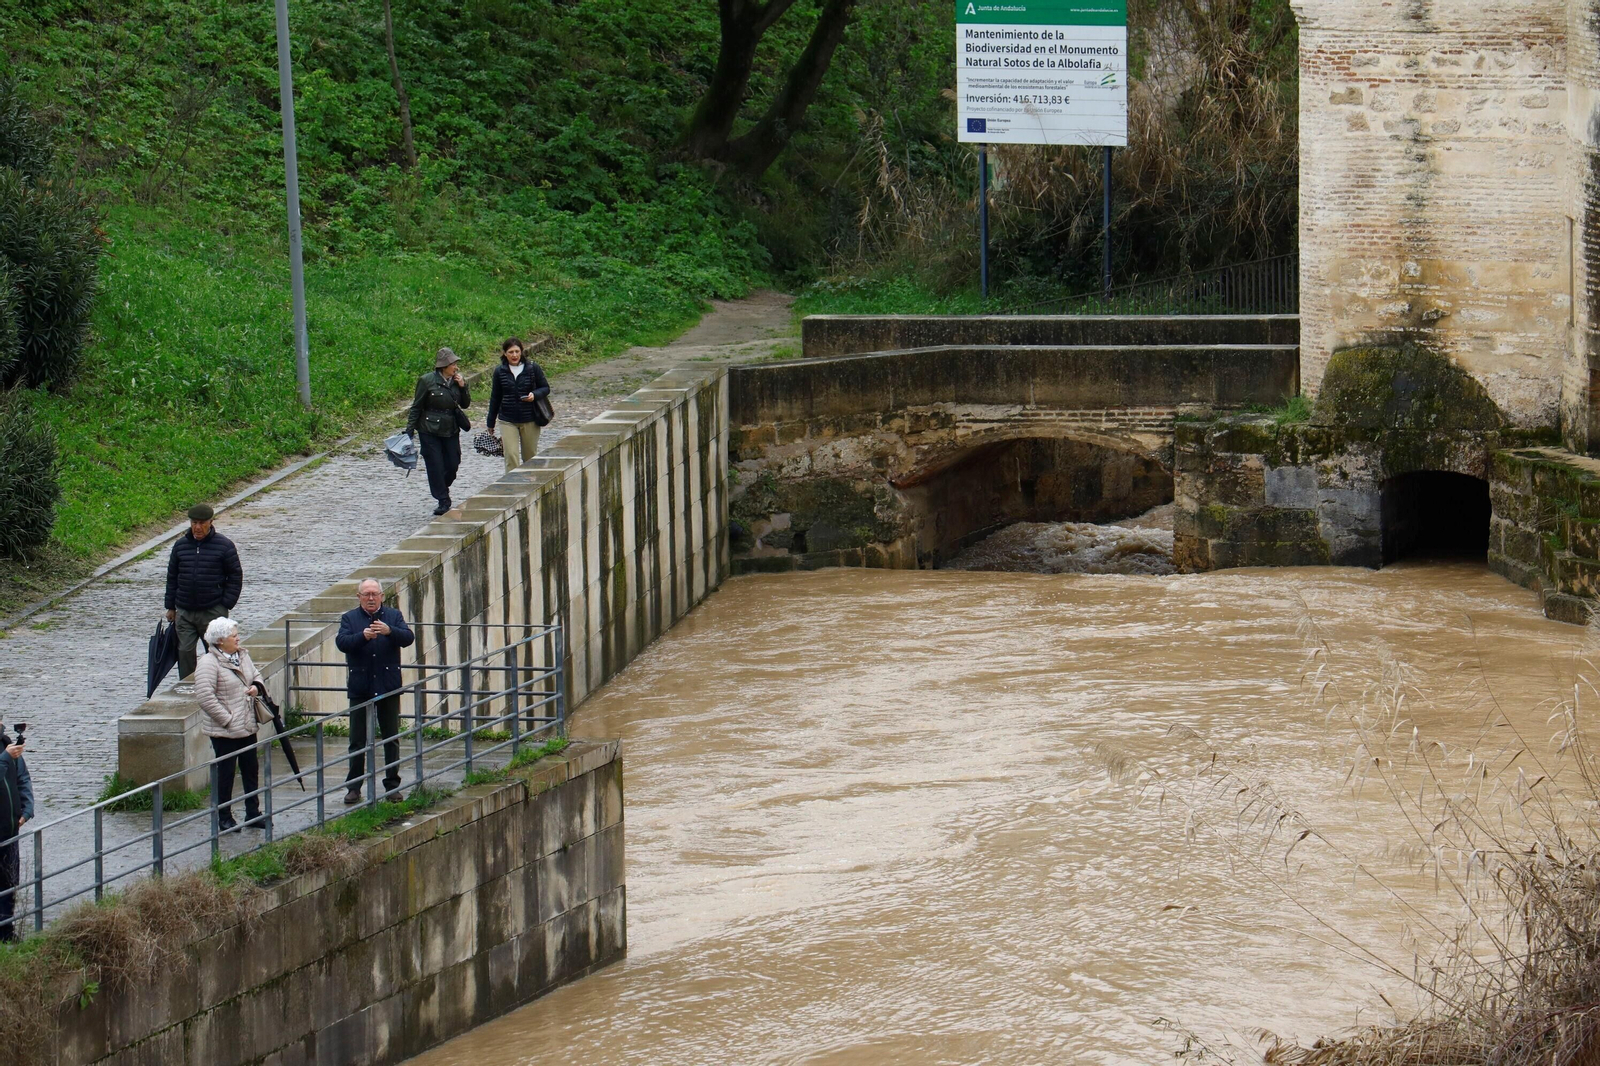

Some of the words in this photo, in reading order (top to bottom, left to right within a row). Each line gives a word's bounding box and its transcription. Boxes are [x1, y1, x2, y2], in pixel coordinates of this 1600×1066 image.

[965, 29, 1039, 39] Mantenimiento
[1041, 30, 1053, 40] de
[1056, 30, 1064, 40] la
[966, 43, 1032, 53] Biodiversidad
[1048, 44, 1057, 54] el
[1060, 45, 1118, 55] Monumento
[966, 57, 1001, 67] Natural
[1004, 58, 1030, 67] Sotos
[1033, 58, 1044, 68] de
[1047, 58, 1055, 68] la
[1058, 59, 1101, 68] Albolafia
[966, 93, 1011, 103] Inversión:
[1013, 95, 1062, 106] 416.713,83
[1065, 96, 1070, 104] €
